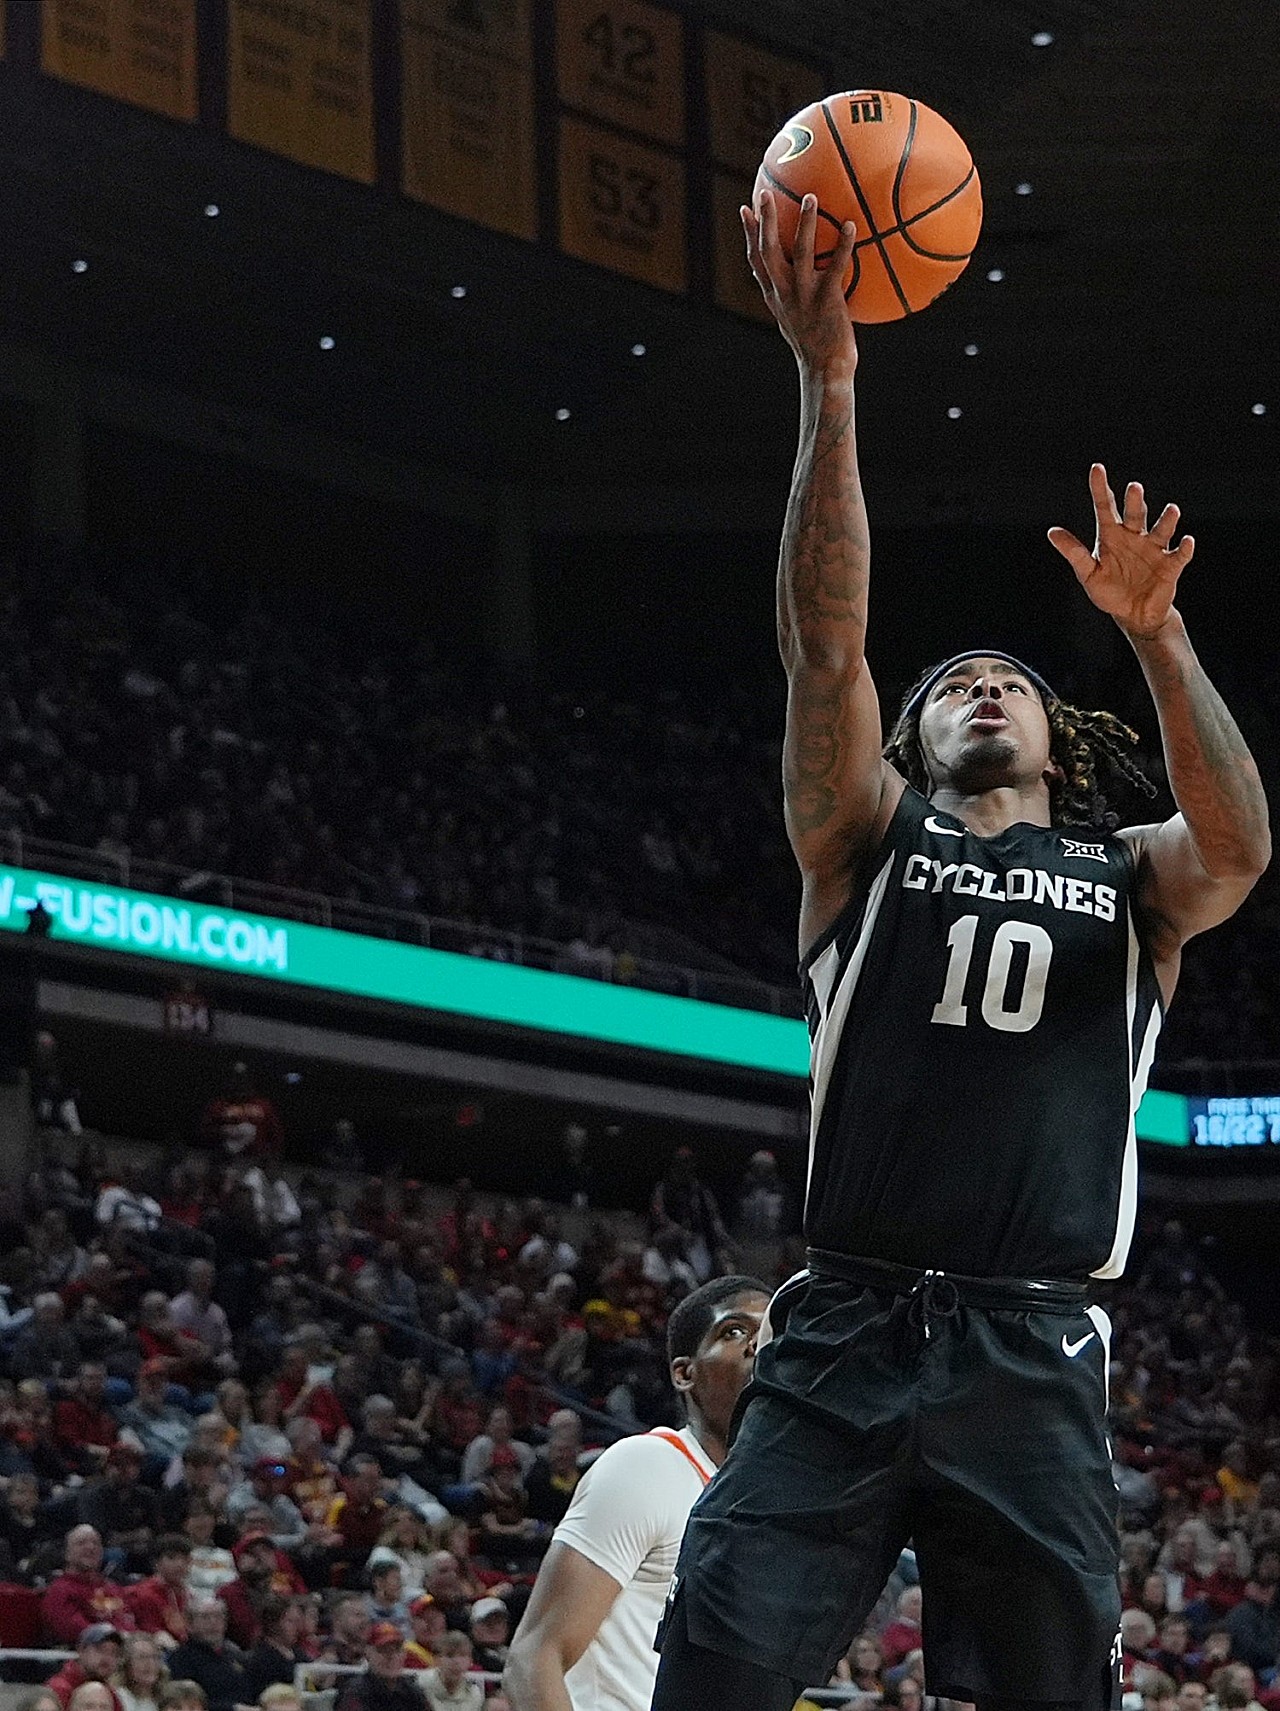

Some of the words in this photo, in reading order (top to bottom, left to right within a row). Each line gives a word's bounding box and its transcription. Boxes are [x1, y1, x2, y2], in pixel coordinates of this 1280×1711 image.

[589, 151, 661, 231] 53
[902, 854, 1117, 922] CYCLONES
[931, 914, 1053, 1033] 10
